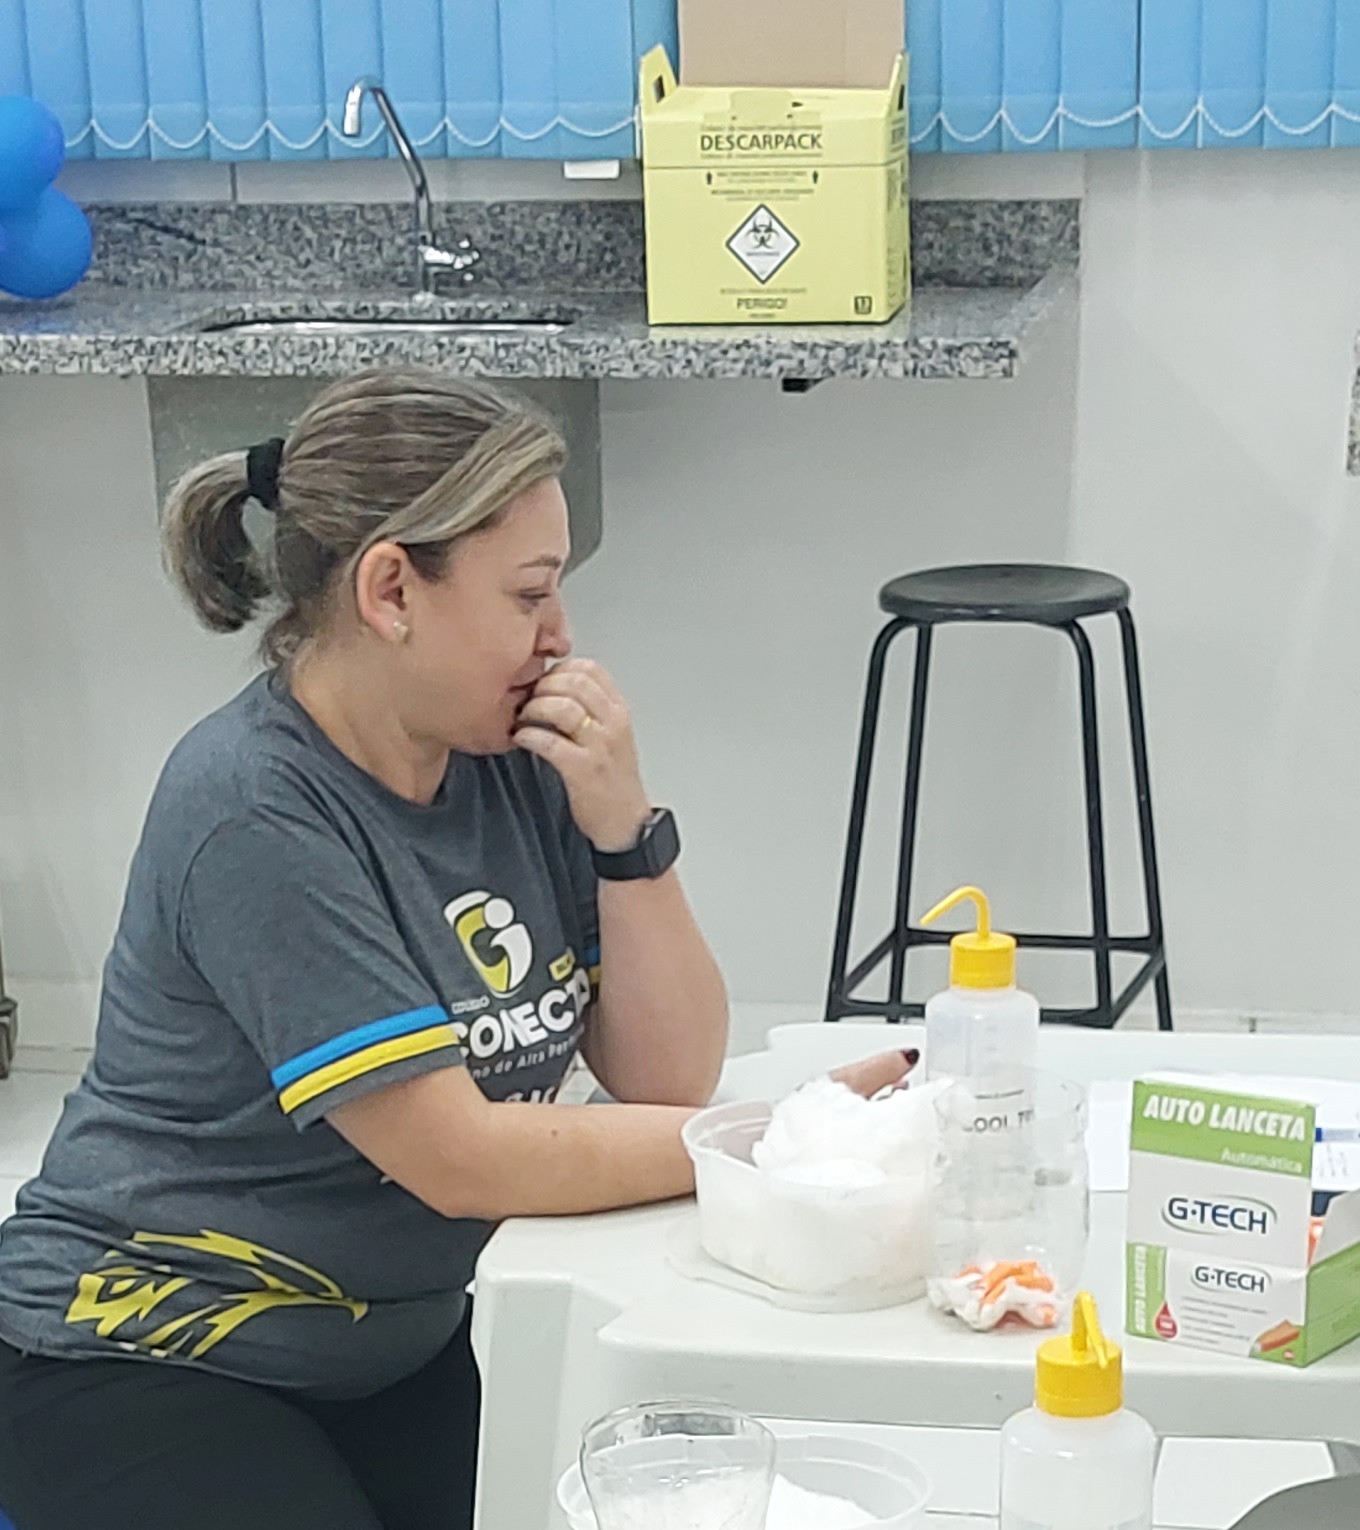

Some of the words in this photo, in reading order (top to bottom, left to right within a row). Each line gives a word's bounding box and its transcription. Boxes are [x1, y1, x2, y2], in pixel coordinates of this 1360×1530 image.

[700, 132, 823, 151] DESCARPACK
[1143, 1094, 1206, 1126] AUTO
[1208, 1102, 1306, 1142] LANCETA
